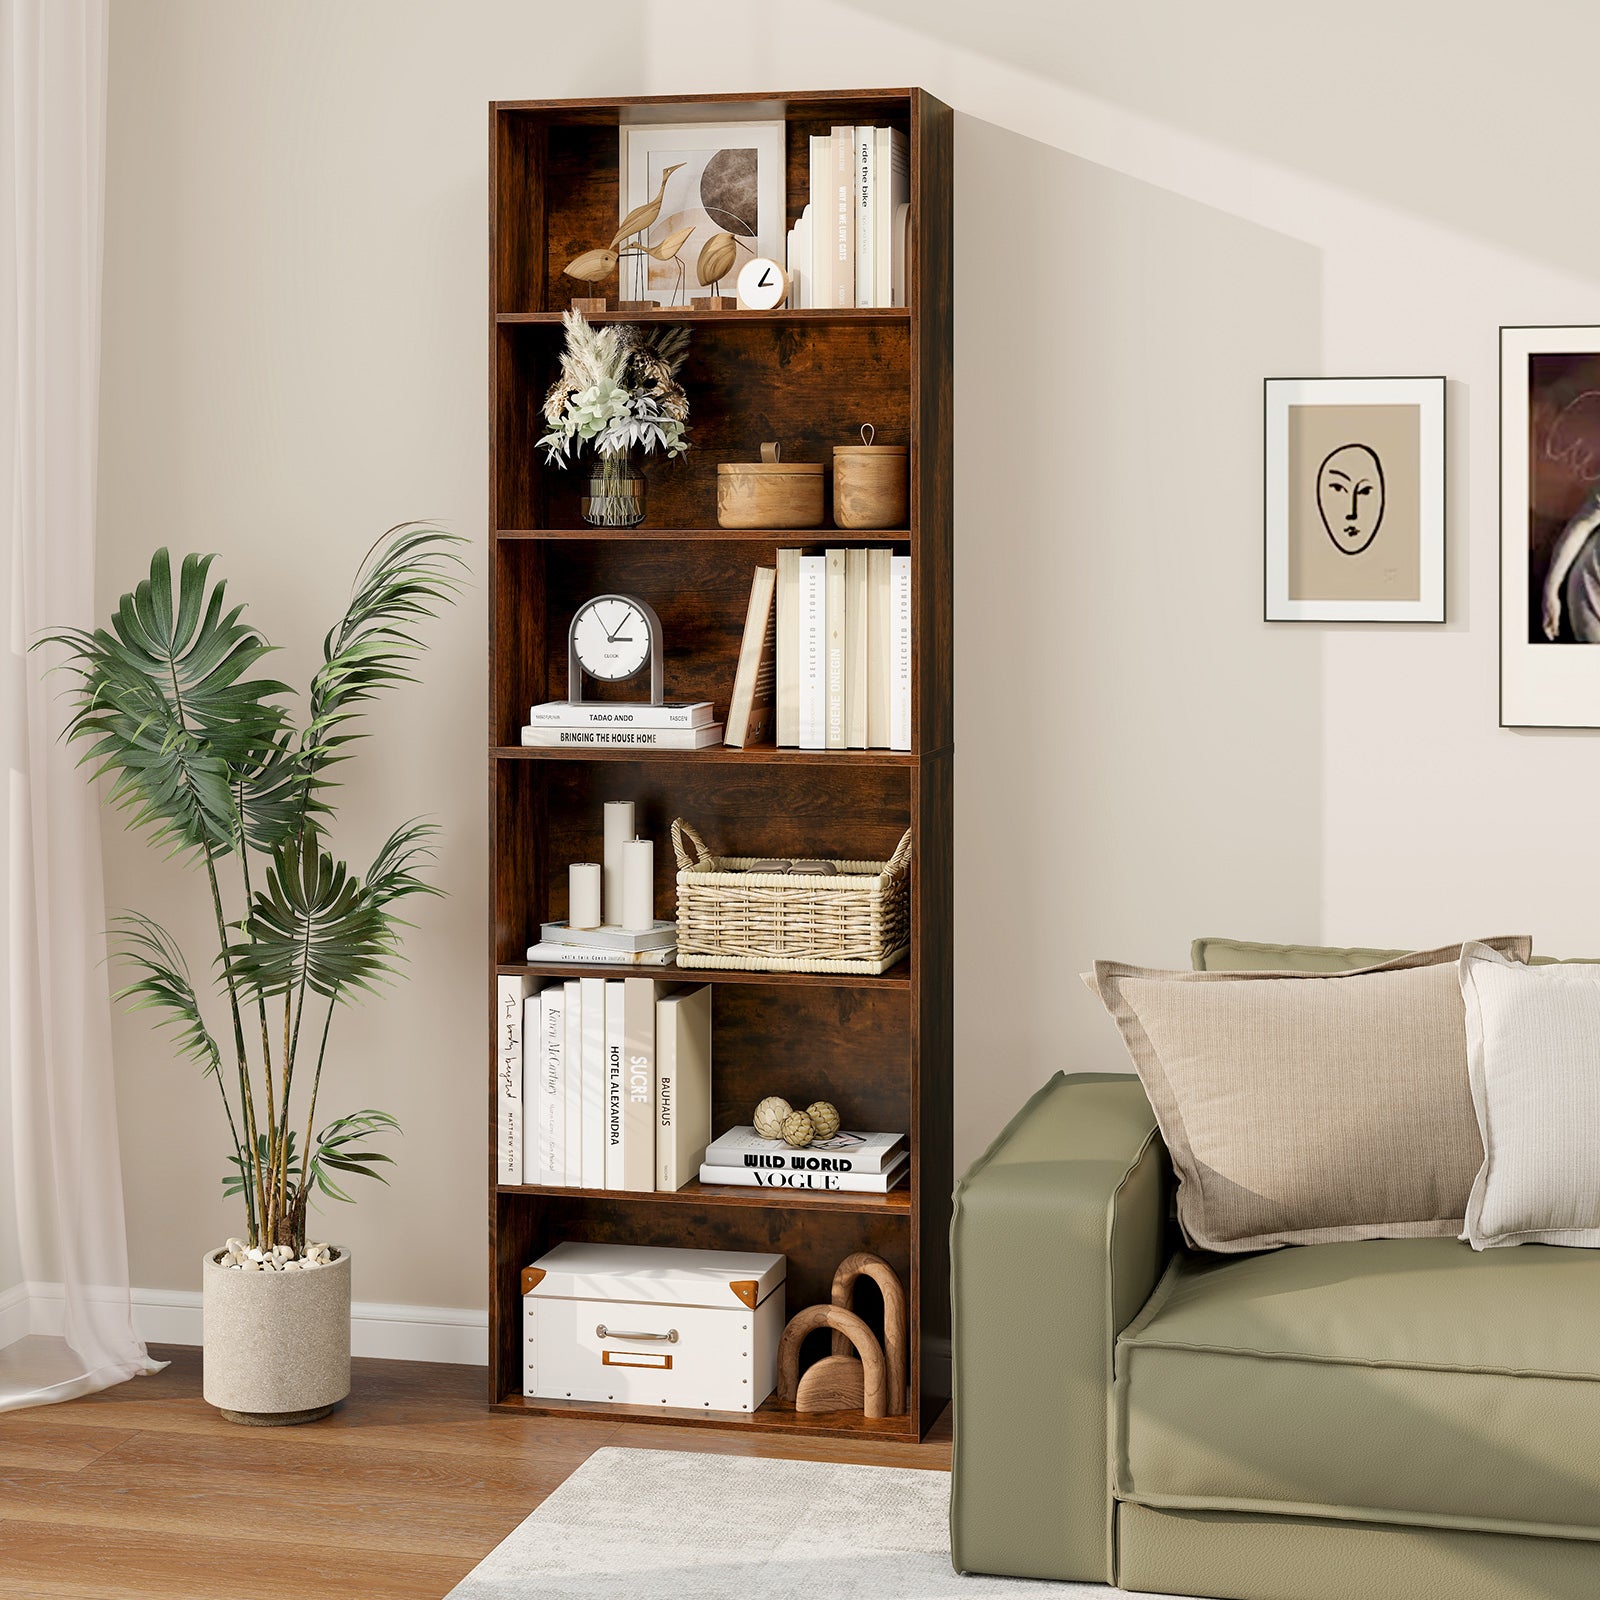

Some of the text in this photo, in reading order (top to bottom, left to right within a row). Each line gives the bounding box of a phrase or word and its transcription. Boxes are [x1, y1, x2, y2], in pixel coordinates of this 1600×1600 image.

[839, 185, 847, 261] WHY DO WE LOVE CATS
[830, 650, 840, 741] EUGENE ONEGIN
[589, 714, 634, 722] TADAO ANDO
[560, 732, 657, 744] BRINGING THE HOUSE HOME
[504, 993, 516, 1020] The
[504, 1024, 519, 1050] body
[548, 1008, 561, 1038] Karen
[548, 1040, 561, 1096] McCartney
[630, 1056, 648, 1104] SUCRE
[610, 1046, 620, 1146] HOTEL ALEXANDRA
[661, 1077, 670, 1127] BAUHAUS
[744, 1154, 852, 1172] WILD WORLD
[754, 1172, 840, 1190] VOGUE
